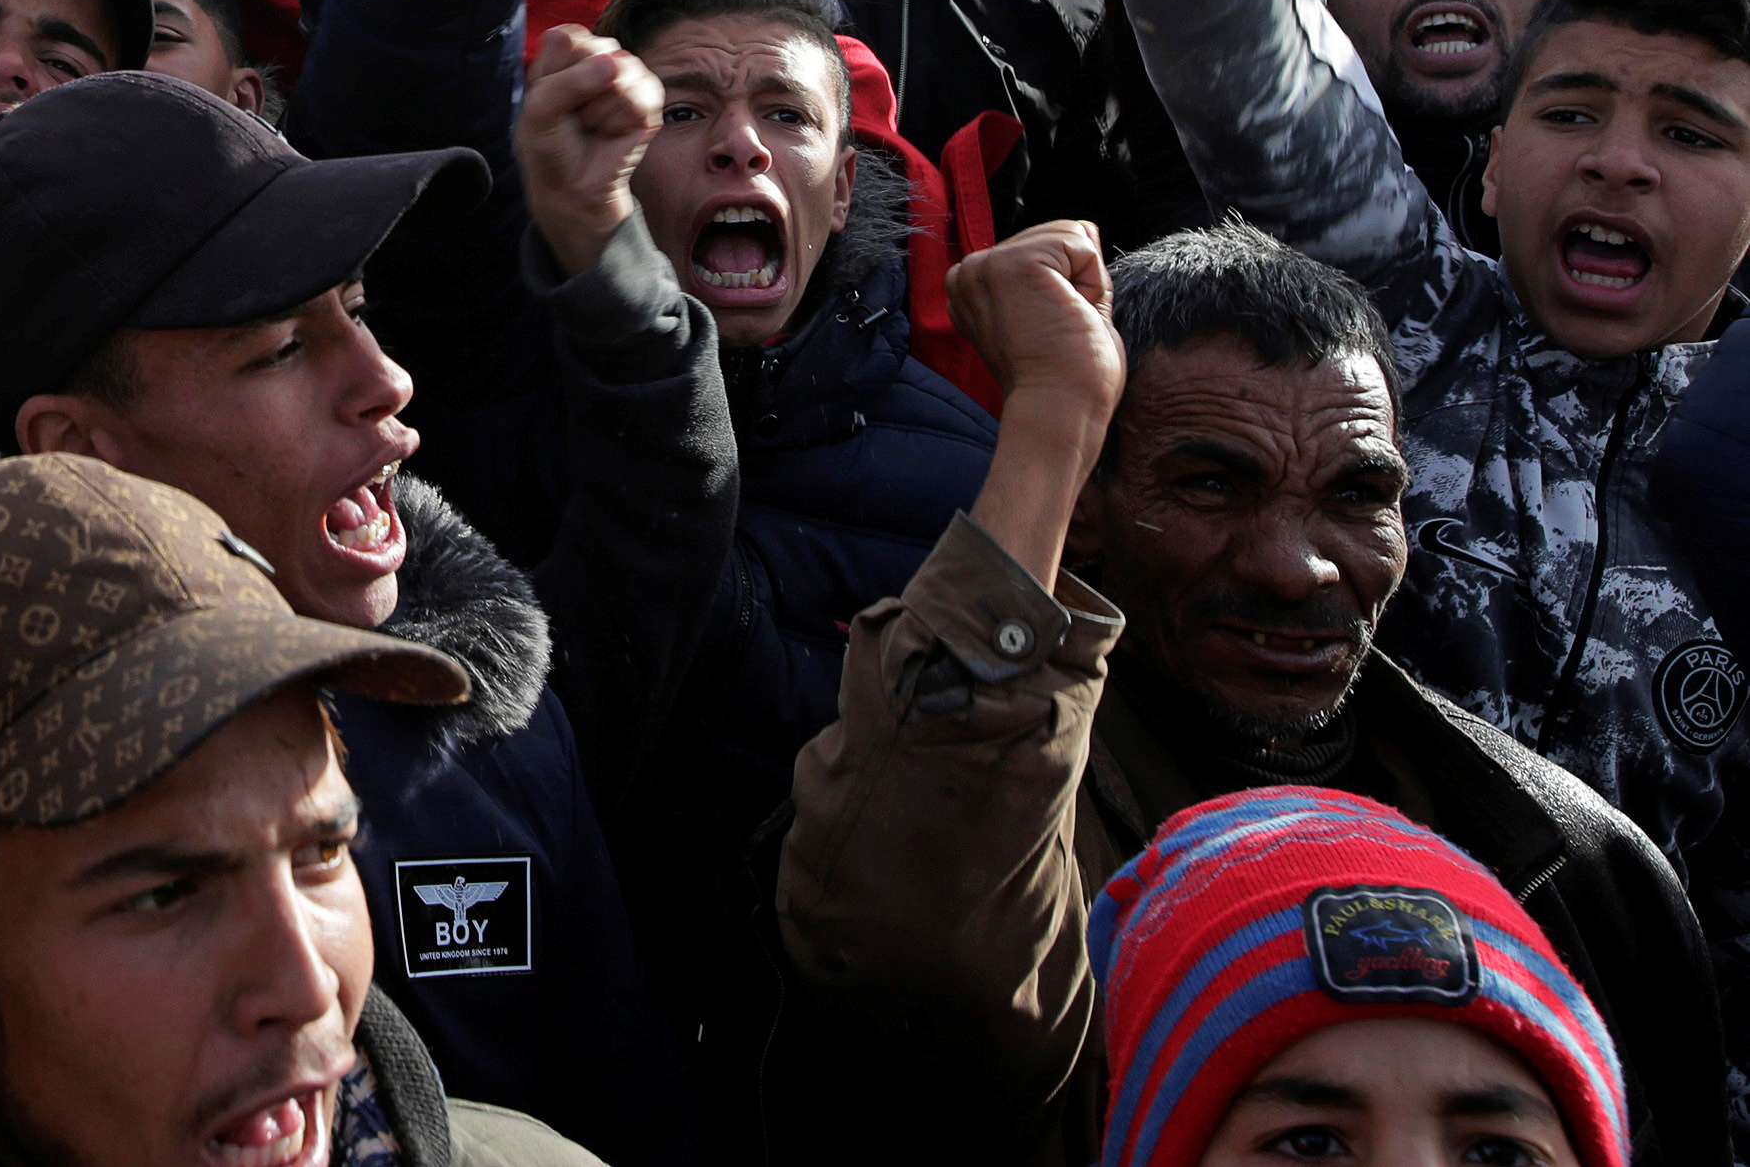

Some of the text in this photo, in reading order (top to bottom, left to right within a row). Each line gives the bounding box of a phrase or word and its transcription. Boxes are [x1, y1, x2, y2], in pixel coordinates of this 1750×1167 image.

[1685, 650, 1745, 686] PARIS
[435, 919, 489, 946] BOY
[419, 951, 441, 961] UNITED
[441, 949, 470, 959] KINGDOM
[471, 947, 491, 957] SINCE
